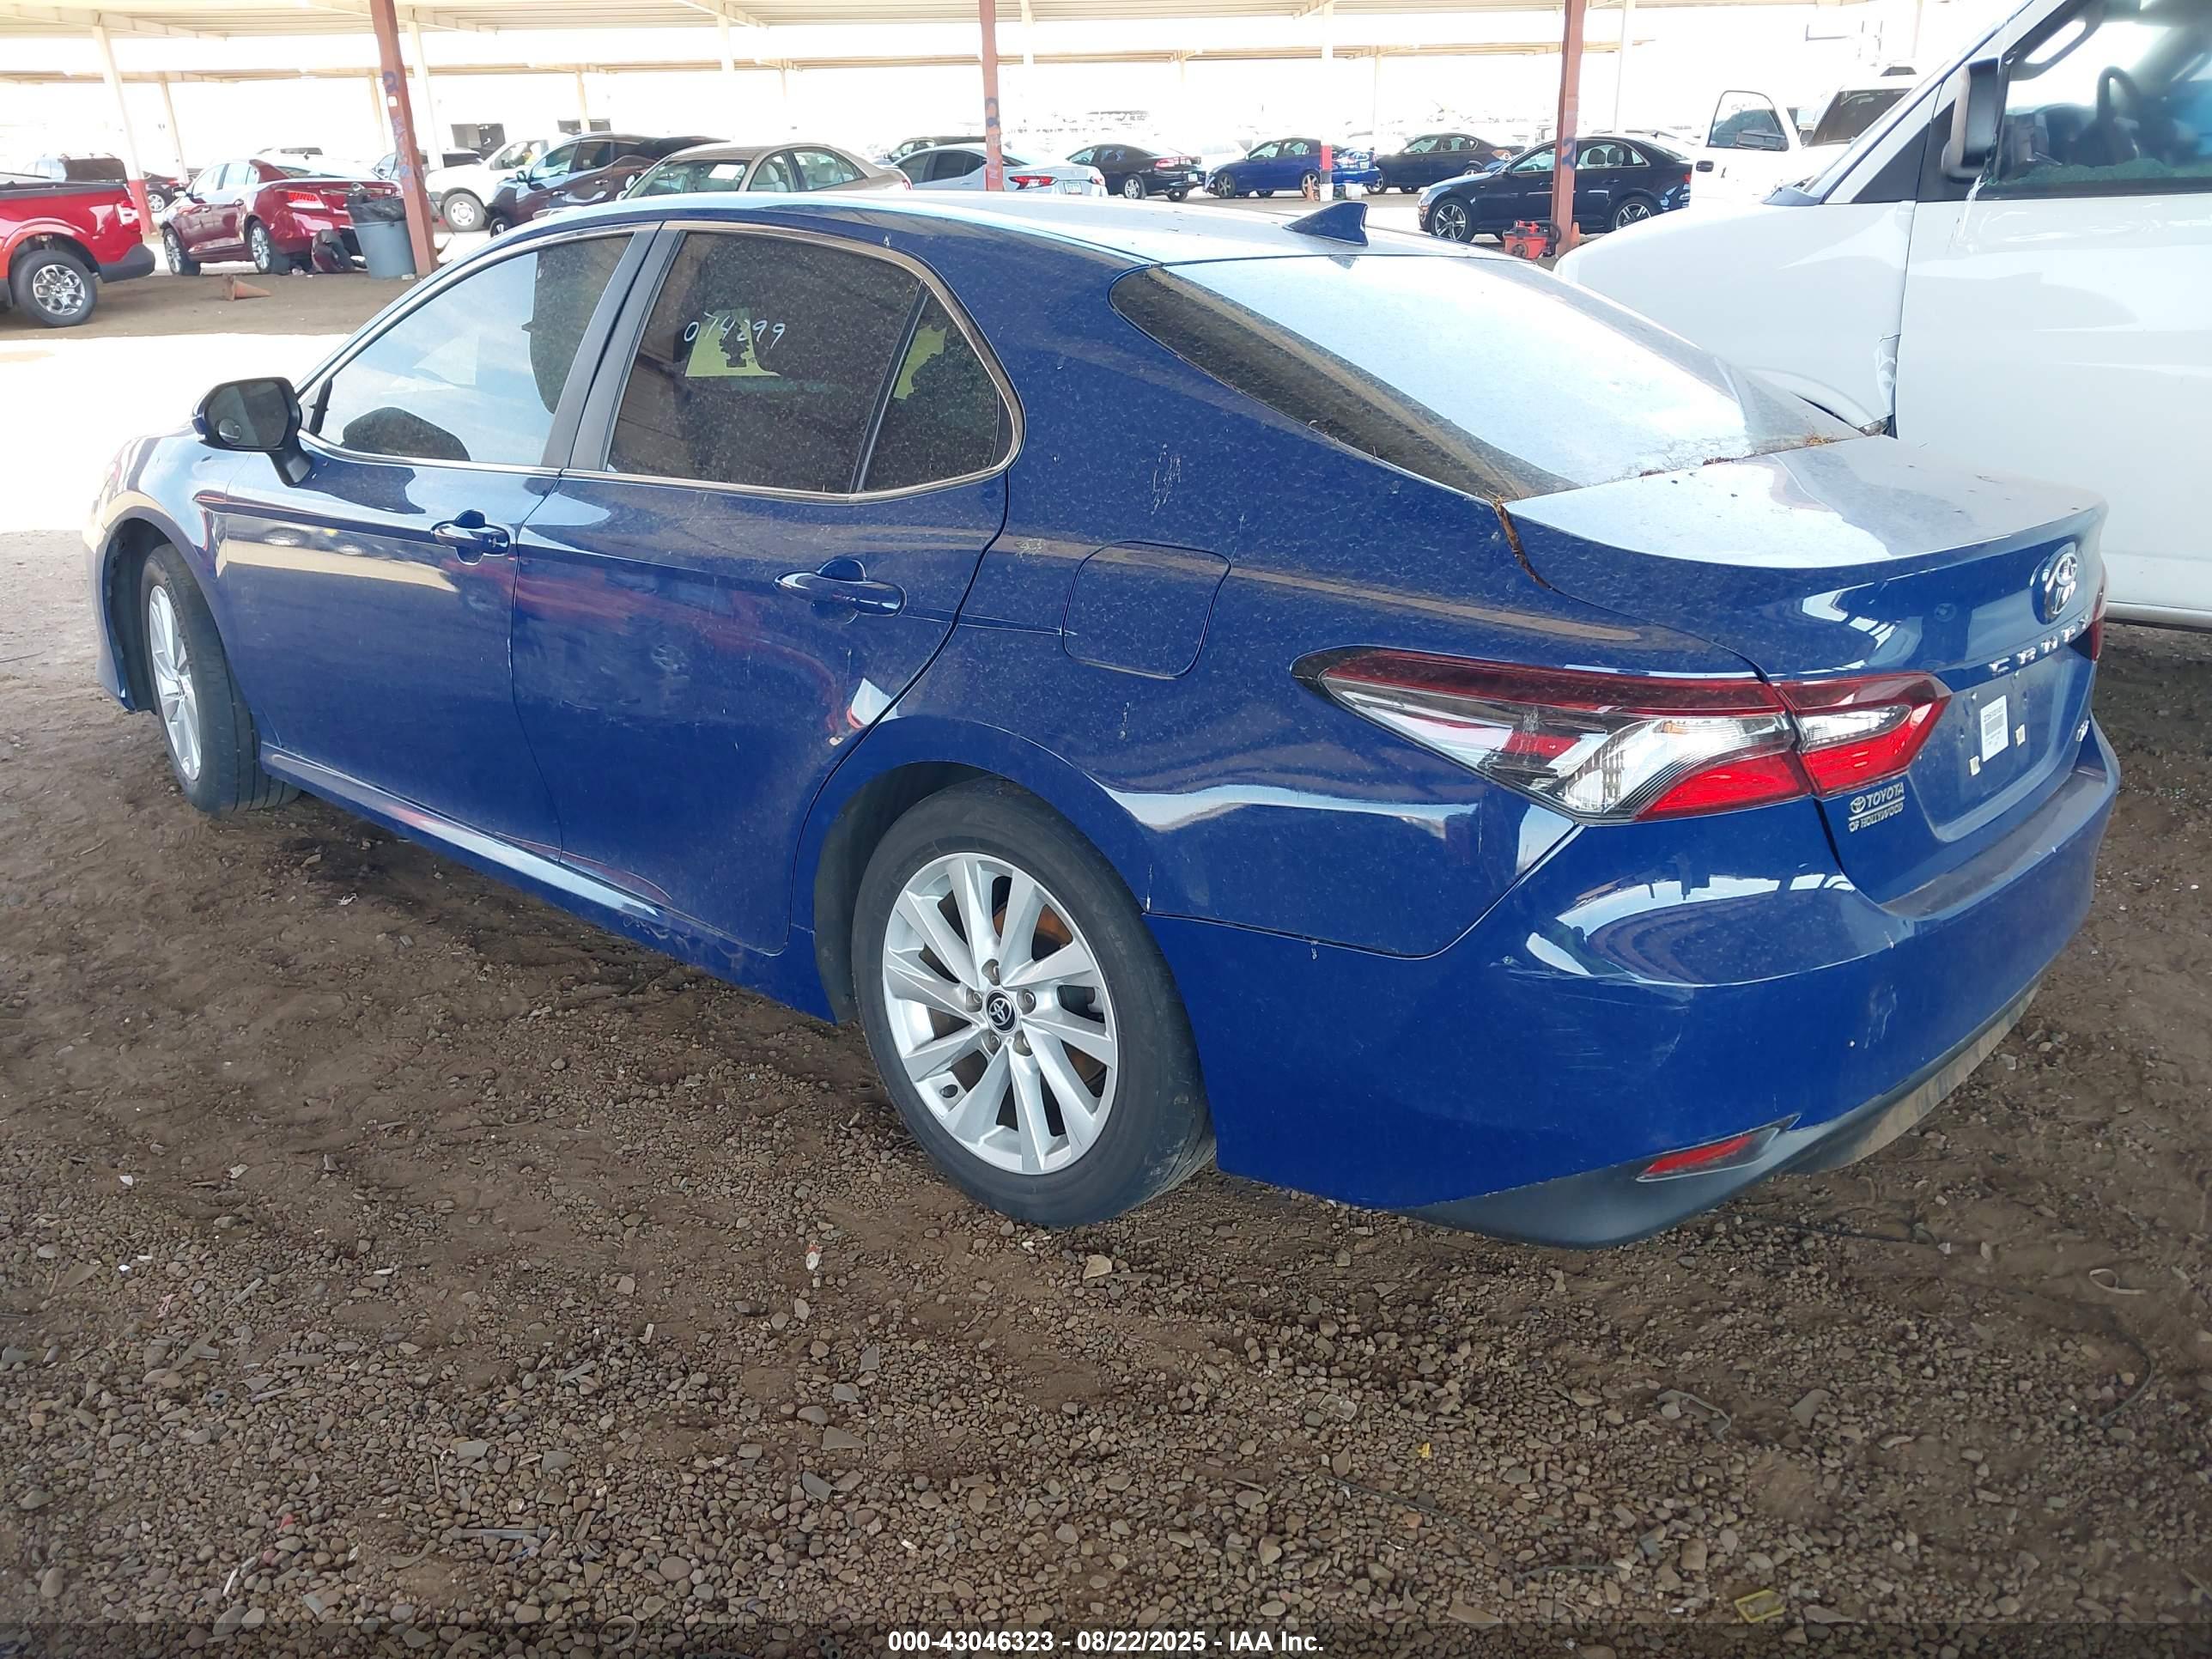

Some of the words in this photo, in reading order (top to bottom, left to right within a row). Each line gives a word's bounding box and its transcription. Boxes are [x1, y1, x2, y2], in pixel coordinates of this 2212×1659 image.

[1866, 782, 1905, 808] TOYOTA
[1849, 820, 1860, 832] OF
[1860, 802, 1904, 829] HOLLYWOOD
